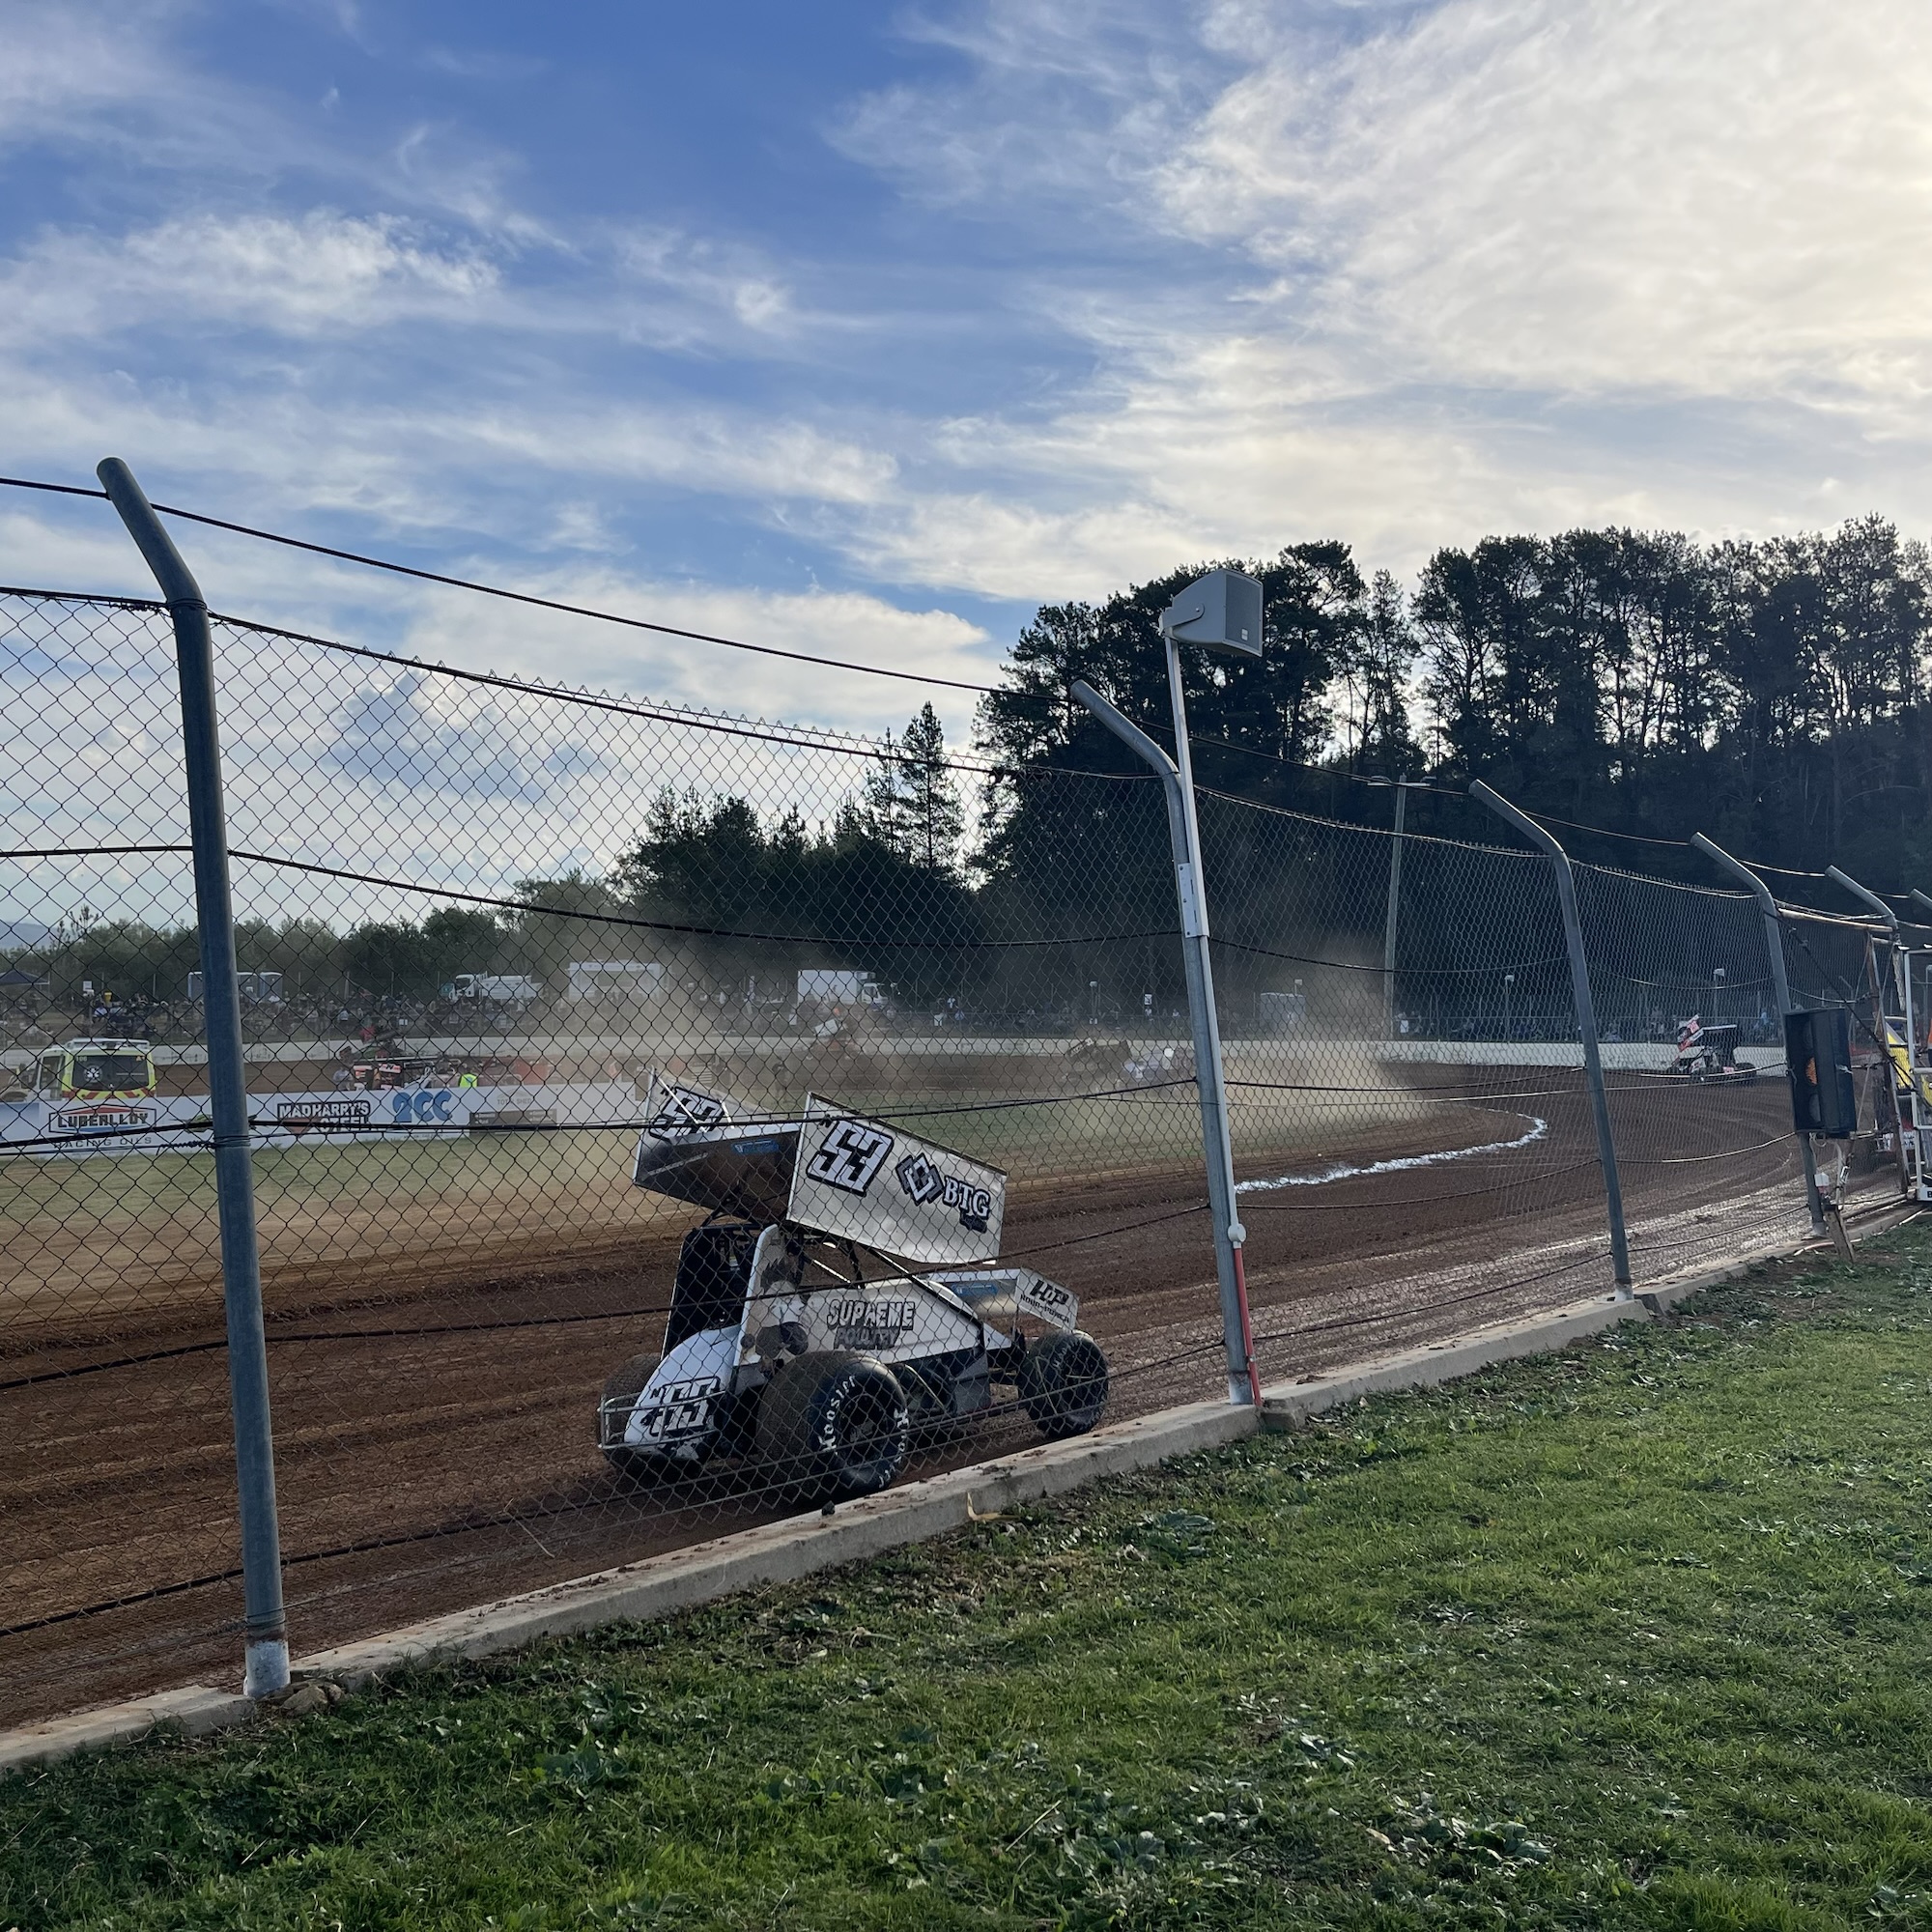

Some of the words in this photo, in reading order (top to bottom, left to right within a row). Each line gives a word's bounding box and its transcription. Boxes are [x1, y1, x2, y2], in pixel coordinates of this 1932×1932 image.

[279, 1102, 369, 1118] MADHARRY'S
[806, 1119, 895, 1197] 53
[942, 1175, 991, 1221] BTG
[827, 1299, 916, 1330] SUPREME
